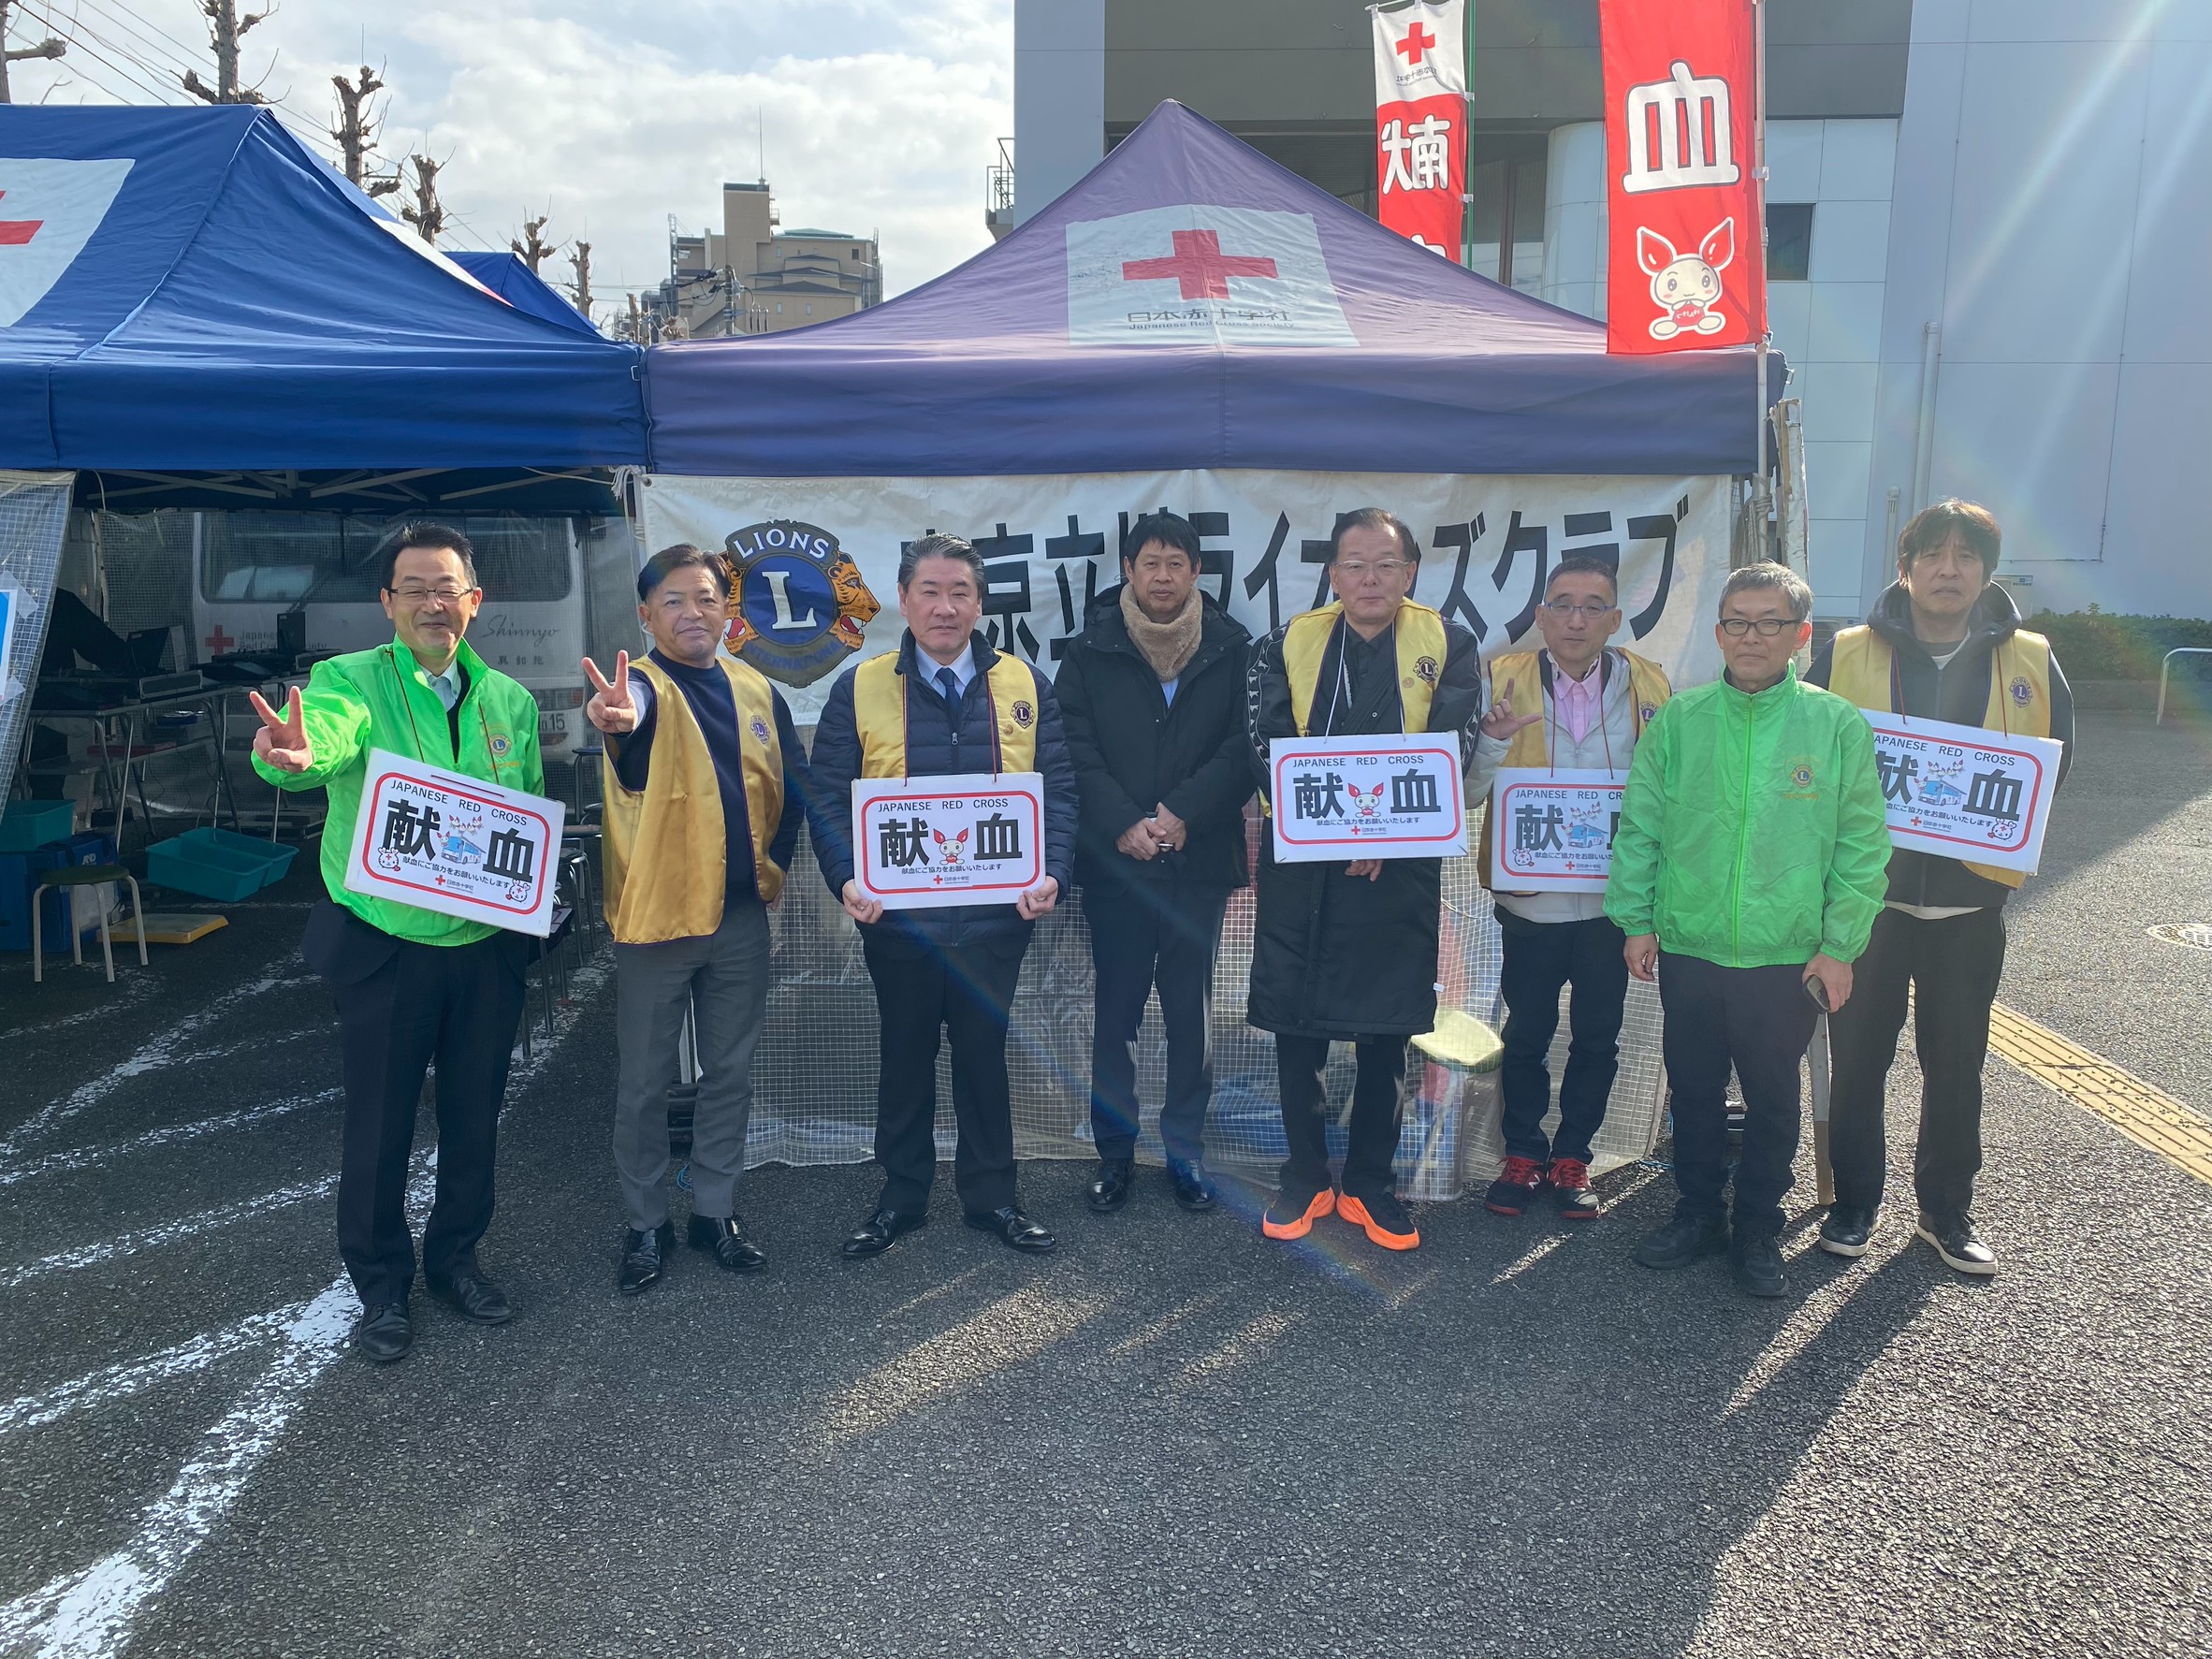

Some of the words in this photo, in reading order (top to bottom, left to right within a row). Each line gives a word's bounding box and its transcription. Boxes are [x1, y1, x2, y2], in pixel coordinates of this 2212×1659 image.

[1128, 308, 1292, 322] 日本赤十字社
[1129, 320, 1186, 329] Japanese
[1190, 319, 1212, 327] Red
[733, 528, 829, 559] LIONS
[761, 571, 817, 630] L
[240, 630, 277, 640] Japane
[480, 614, 561, 647] Shinnyo
[1019, 707, 1027, 720] L
[1292, 757, 1346, 768] JAPANESE
[1356, 756, 1378, 765] RED
[1388, 755, 1424, 764] CROSS
[1874, 735, 1928, 752] APANESE
[1939, 745, 1963, 758] RED
[1973, 751, 2016, 766] CROSS
[391, 779, 449, 805] JAPANESE
[458, 798, 481, 813] RED
[491, 808, 528, 826] CROSS
[878, 801, 932, 813] JAPANESE
[941, 800, 964, 810] RED
[973, 798, 1009, 808] CROSS
[1292, 772, 1346, 820] 献
[1390, 768, 1442, 814] 血
[1516, 790, 1568, 799] JAPANESE
[1578, 791, 1598, 800] RED
[1962, 768, 2024, 822] 血
[1316, 816, 1420, 826] 献血にご協力をお願いいたします
[1515, 804, 1564, 851] 献
[1885, 803, 1993, 828] 血にご協力をお願いいたします
[379, 798, 442, 861] 献
[482, 827, 535, 883] 血
[878, 817, 930, 868] 献
[973, 812, 1023, 861] 血
[901, 863, 1003, 875] 献血にご協力をお願いいたします
[1535, 851, 1614, 861] 献血にご協力をお願いいた
[402, 855, 510, 889] 献血にご協力をお願いいたします
